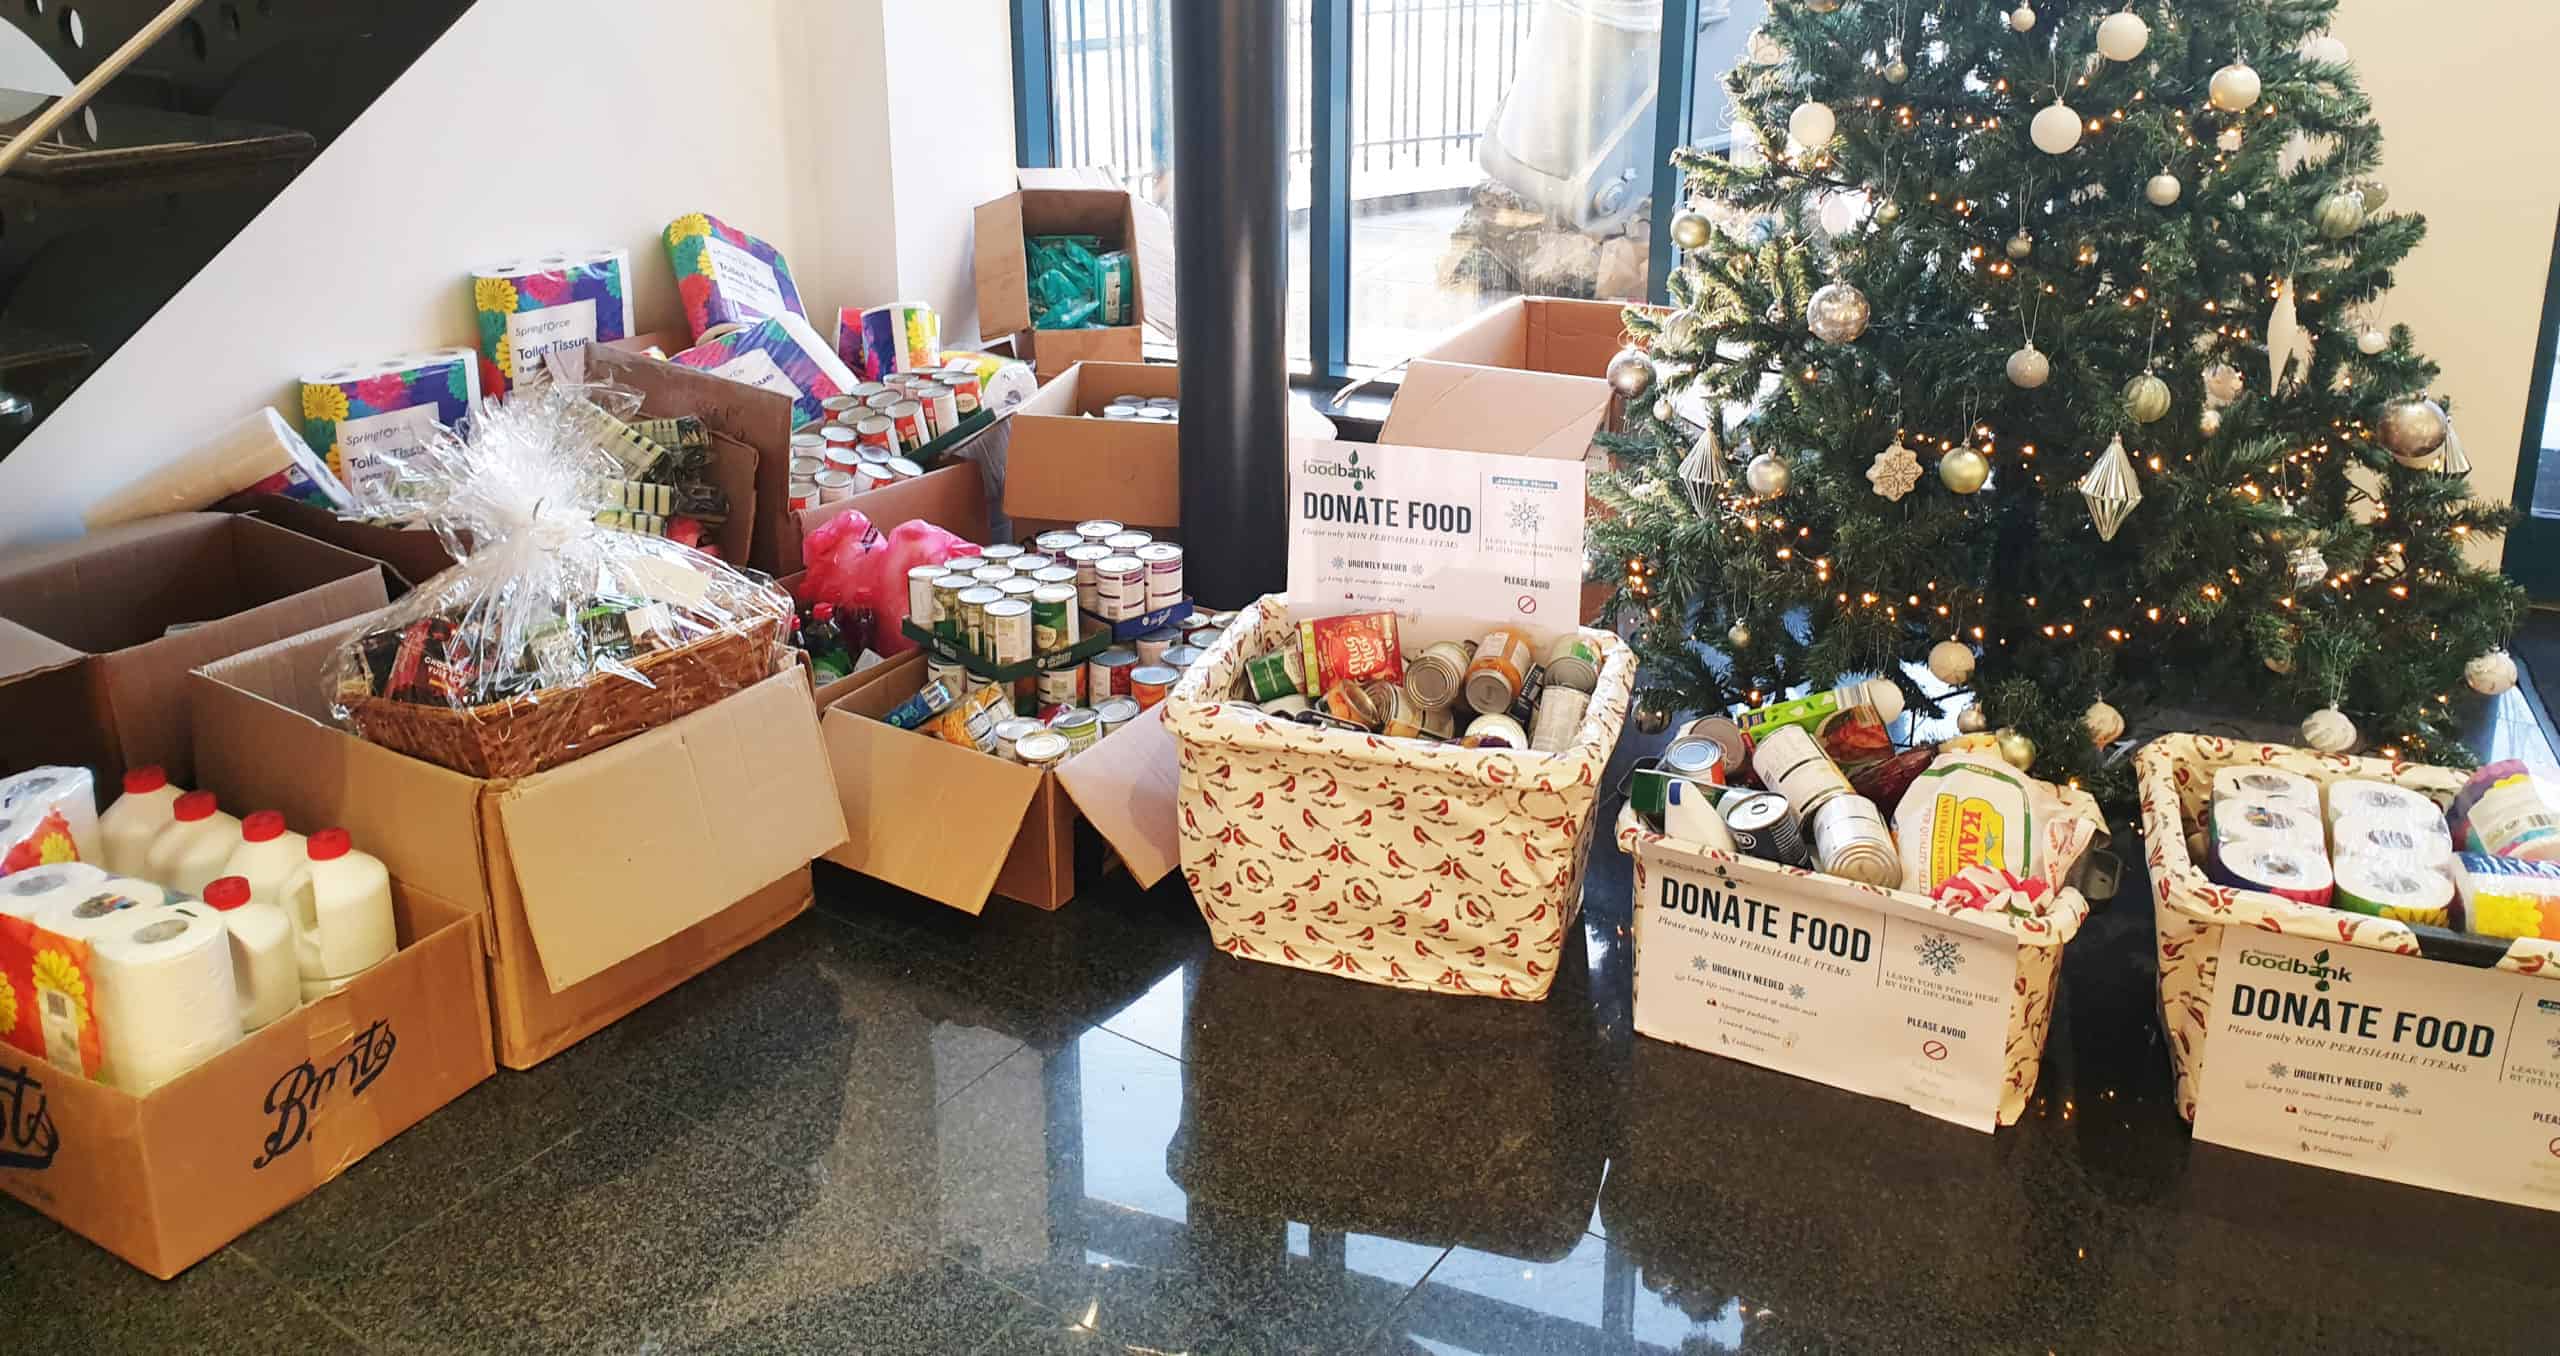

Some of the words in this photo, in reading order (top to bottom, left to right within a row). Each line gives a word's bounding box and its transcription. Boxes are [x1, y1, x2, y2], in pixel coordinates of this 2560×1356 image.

[514, 318, 571, 337] Springforce
[516, 343, 550, 361] Toilet
[1303, 460, 1376, 481] foodbank
[1303, 491, 1400, 528] DONATE
[1407, 501, 1472, 534] FOOD
[1347, 559, 1380, 570] URGENTLY
[1503, 575, 1529, 588] PLEASE
[1530, 578, 1551, 590] AVOID
[1343, 636, 1362, 676] Mug
[1957, 807, 1983, 872] KAM
[1660, 876, 1780, 938] DONATE
[1790, 911, 1871, 963] FOOD
[1657, 914, 1687, 931] Please
[1689, 922, 1710, 938] only
[1712, 927, 1738, 945] NON
[1739, 938, 1811, 967] PERISHABLE
[1813, 958, 1851, 978] ITEMS
[1711, 962, 1752, 982] URGENTLY
[1753, 973, 1784, 991] NEEDED
[2239, 949, 2352, 983] foodbank
[1906, 1016, 1938, 1033] PLEASE
[1940, 1024, 1967, 1041] AVOID
[2231, 983, 2383, 1040] DONATE
[2392, 1011, 2495, 1059] FOOD
[2227, 1023, 2264, 1039] Please
[2265, 1031, 2293, 1045] only
[2294, 1035, 2327, 1049] NON
[2329, 1041, 2419, 1065] PERISHABLE
[2421, 1057, 2469, 1074] ITEMS
[2293, 1068, 2343, 1086] URGENTLY
[2344, 1077, 2383, 1092] NEEDED
[2532, 1111, 2560, 1126] PLEA
